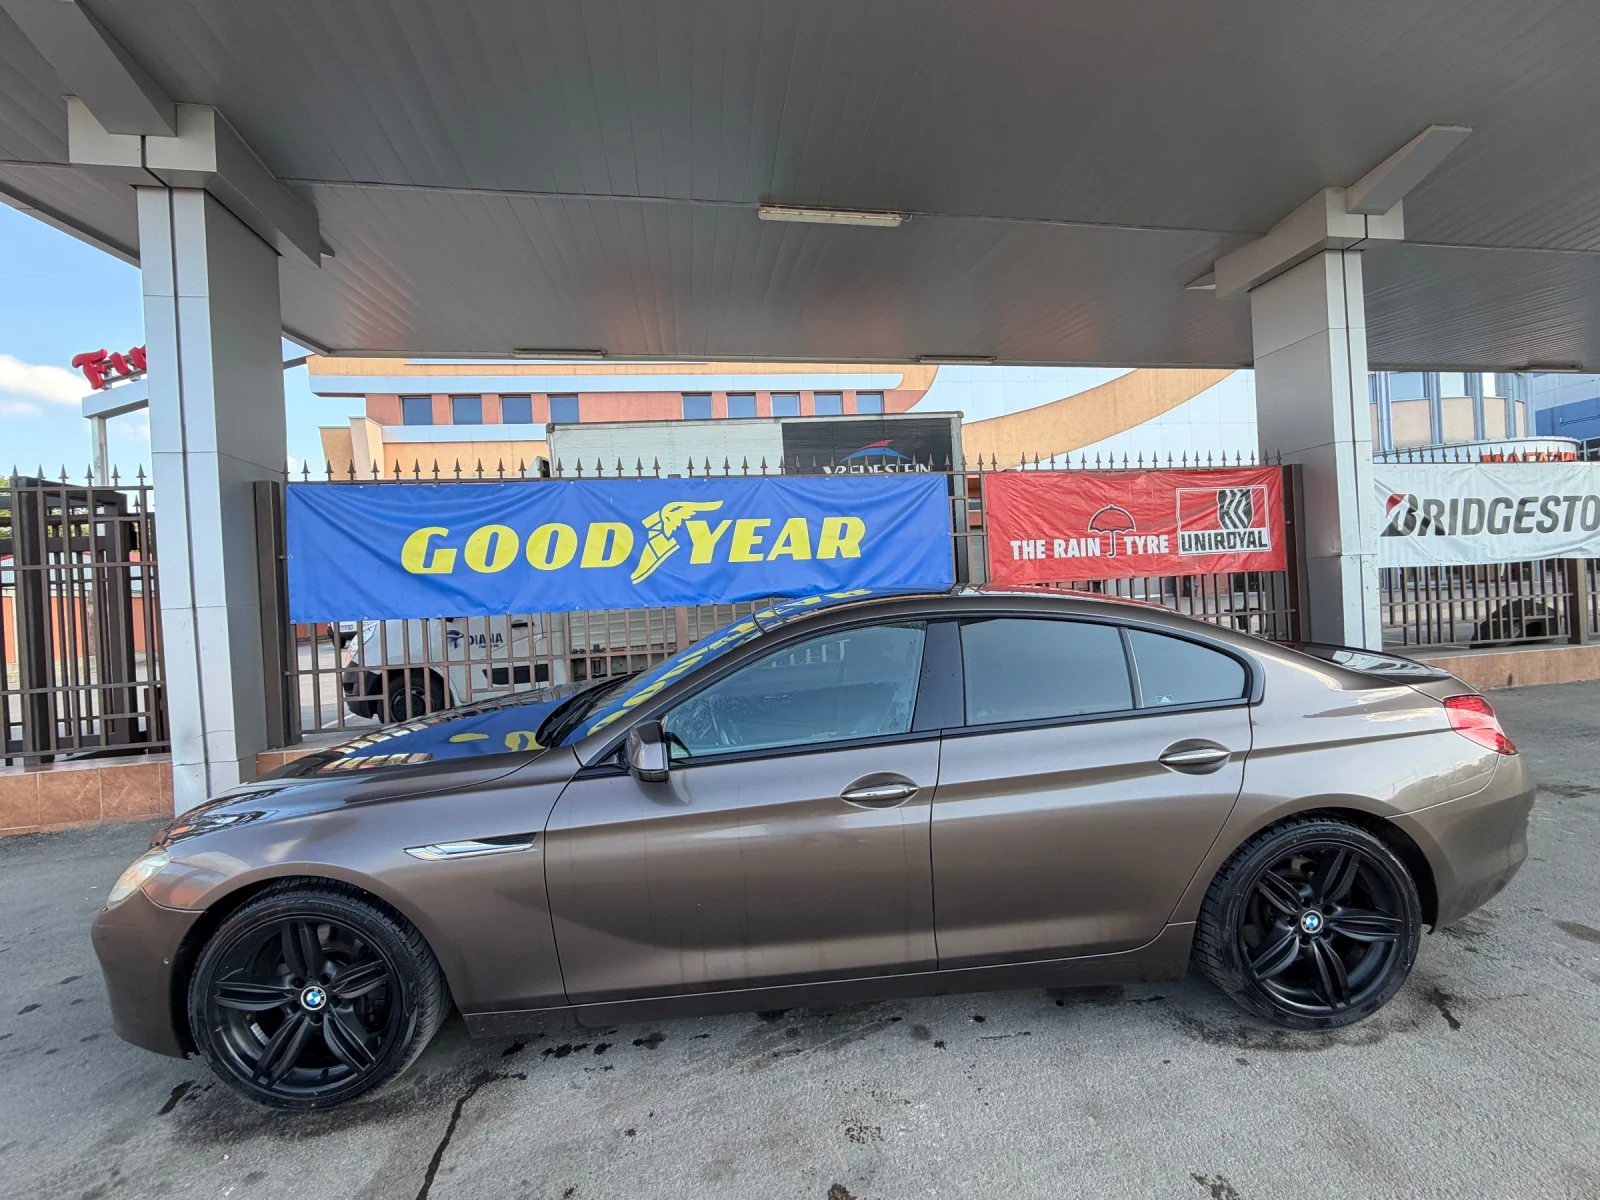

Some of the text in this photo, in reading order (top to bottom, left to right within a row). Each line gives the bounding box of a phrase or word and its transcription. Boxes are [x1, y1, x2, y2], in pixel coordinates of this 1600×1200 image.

[1380, 493, 1600, 537] BRIDGESTO
[401, 516, 866, 574] GOOD YEAR
[1010, 534, 1169, 560] THE RAIN TYRE
[1181, 530, 1269, 552] UNIROYAL
